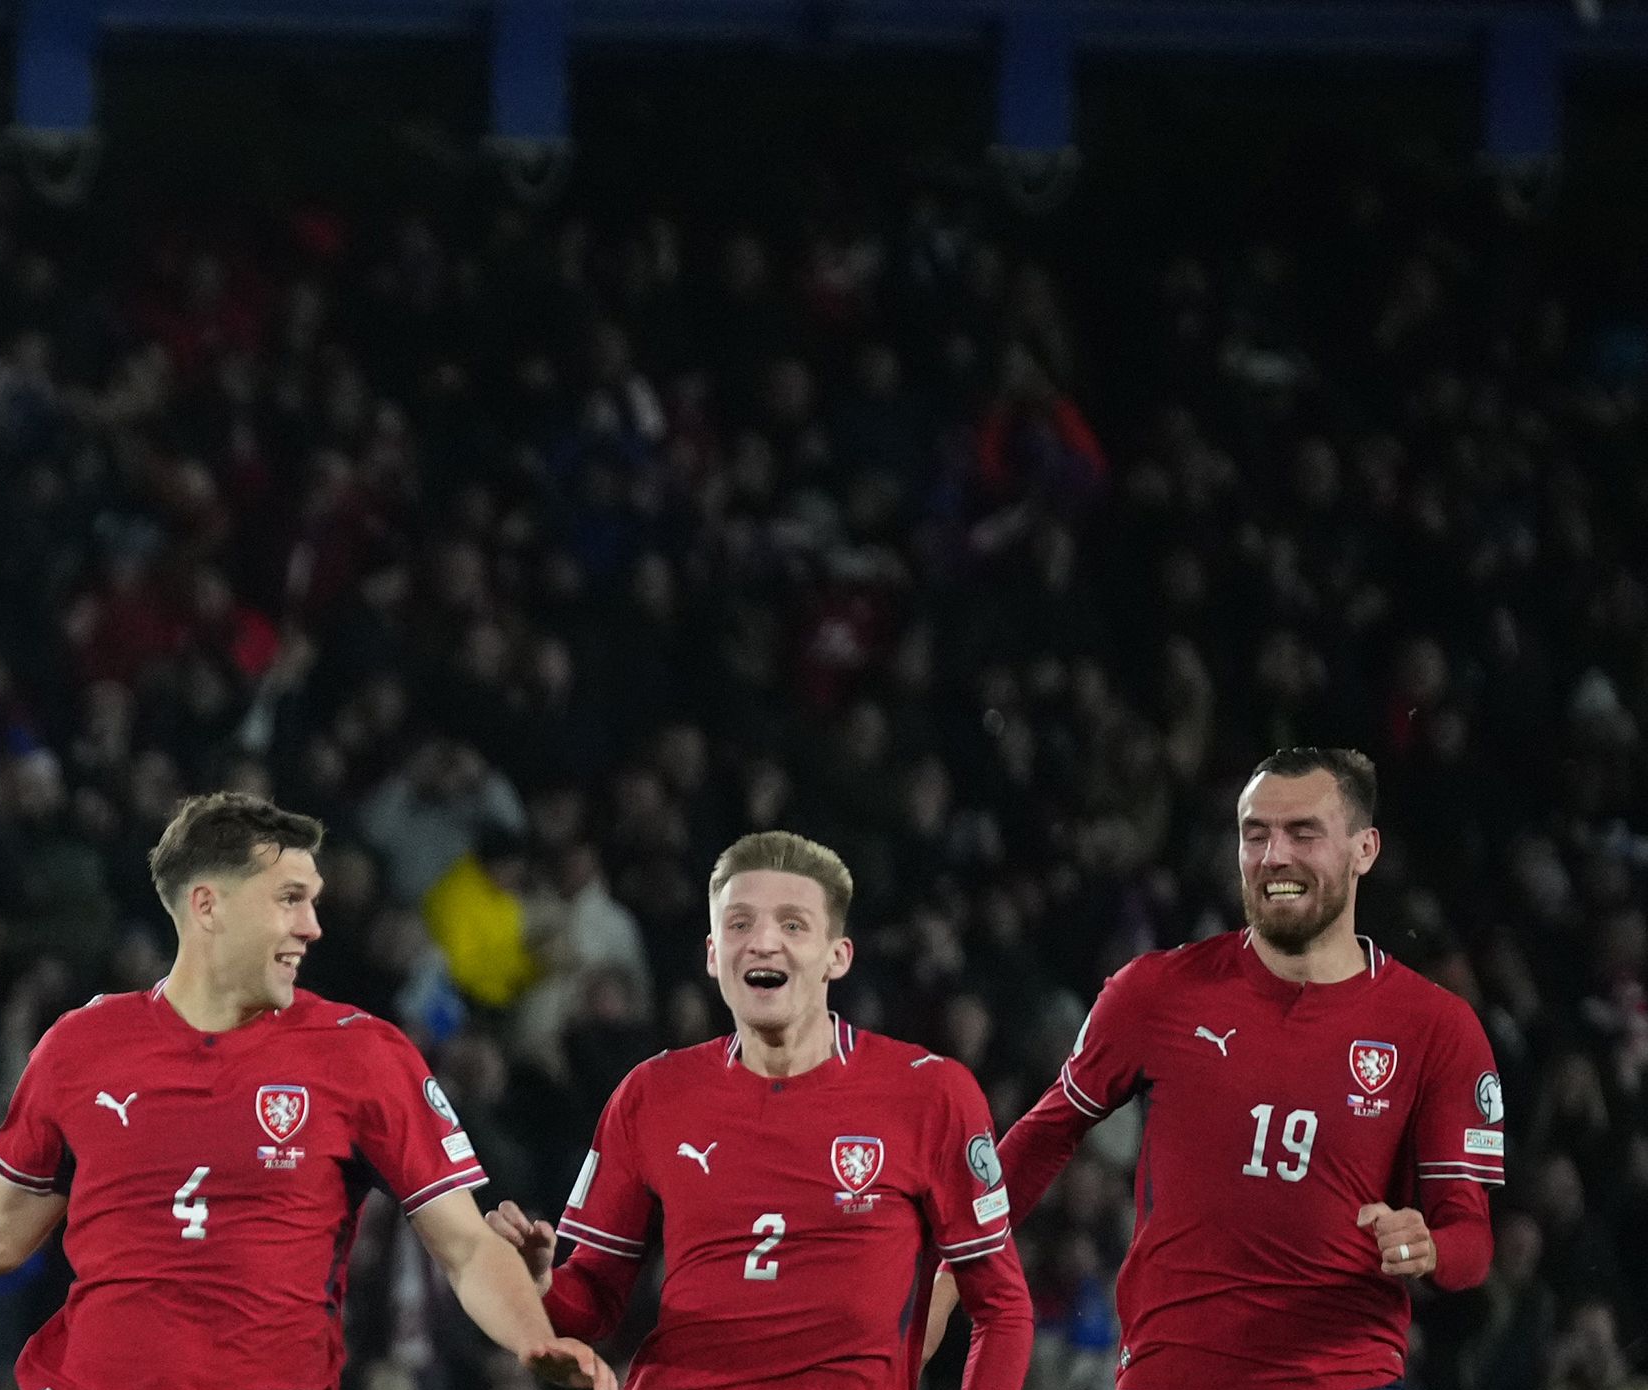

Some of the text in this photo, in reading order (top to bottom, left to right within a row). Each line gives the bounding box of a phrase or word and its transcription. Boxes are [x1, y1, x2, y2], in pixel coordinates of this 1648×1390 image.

[1242, 1103, 1319, 1182] 19
[172, 1166, 209, 1239] 4
[743, 1213, 787, 1280] 2
